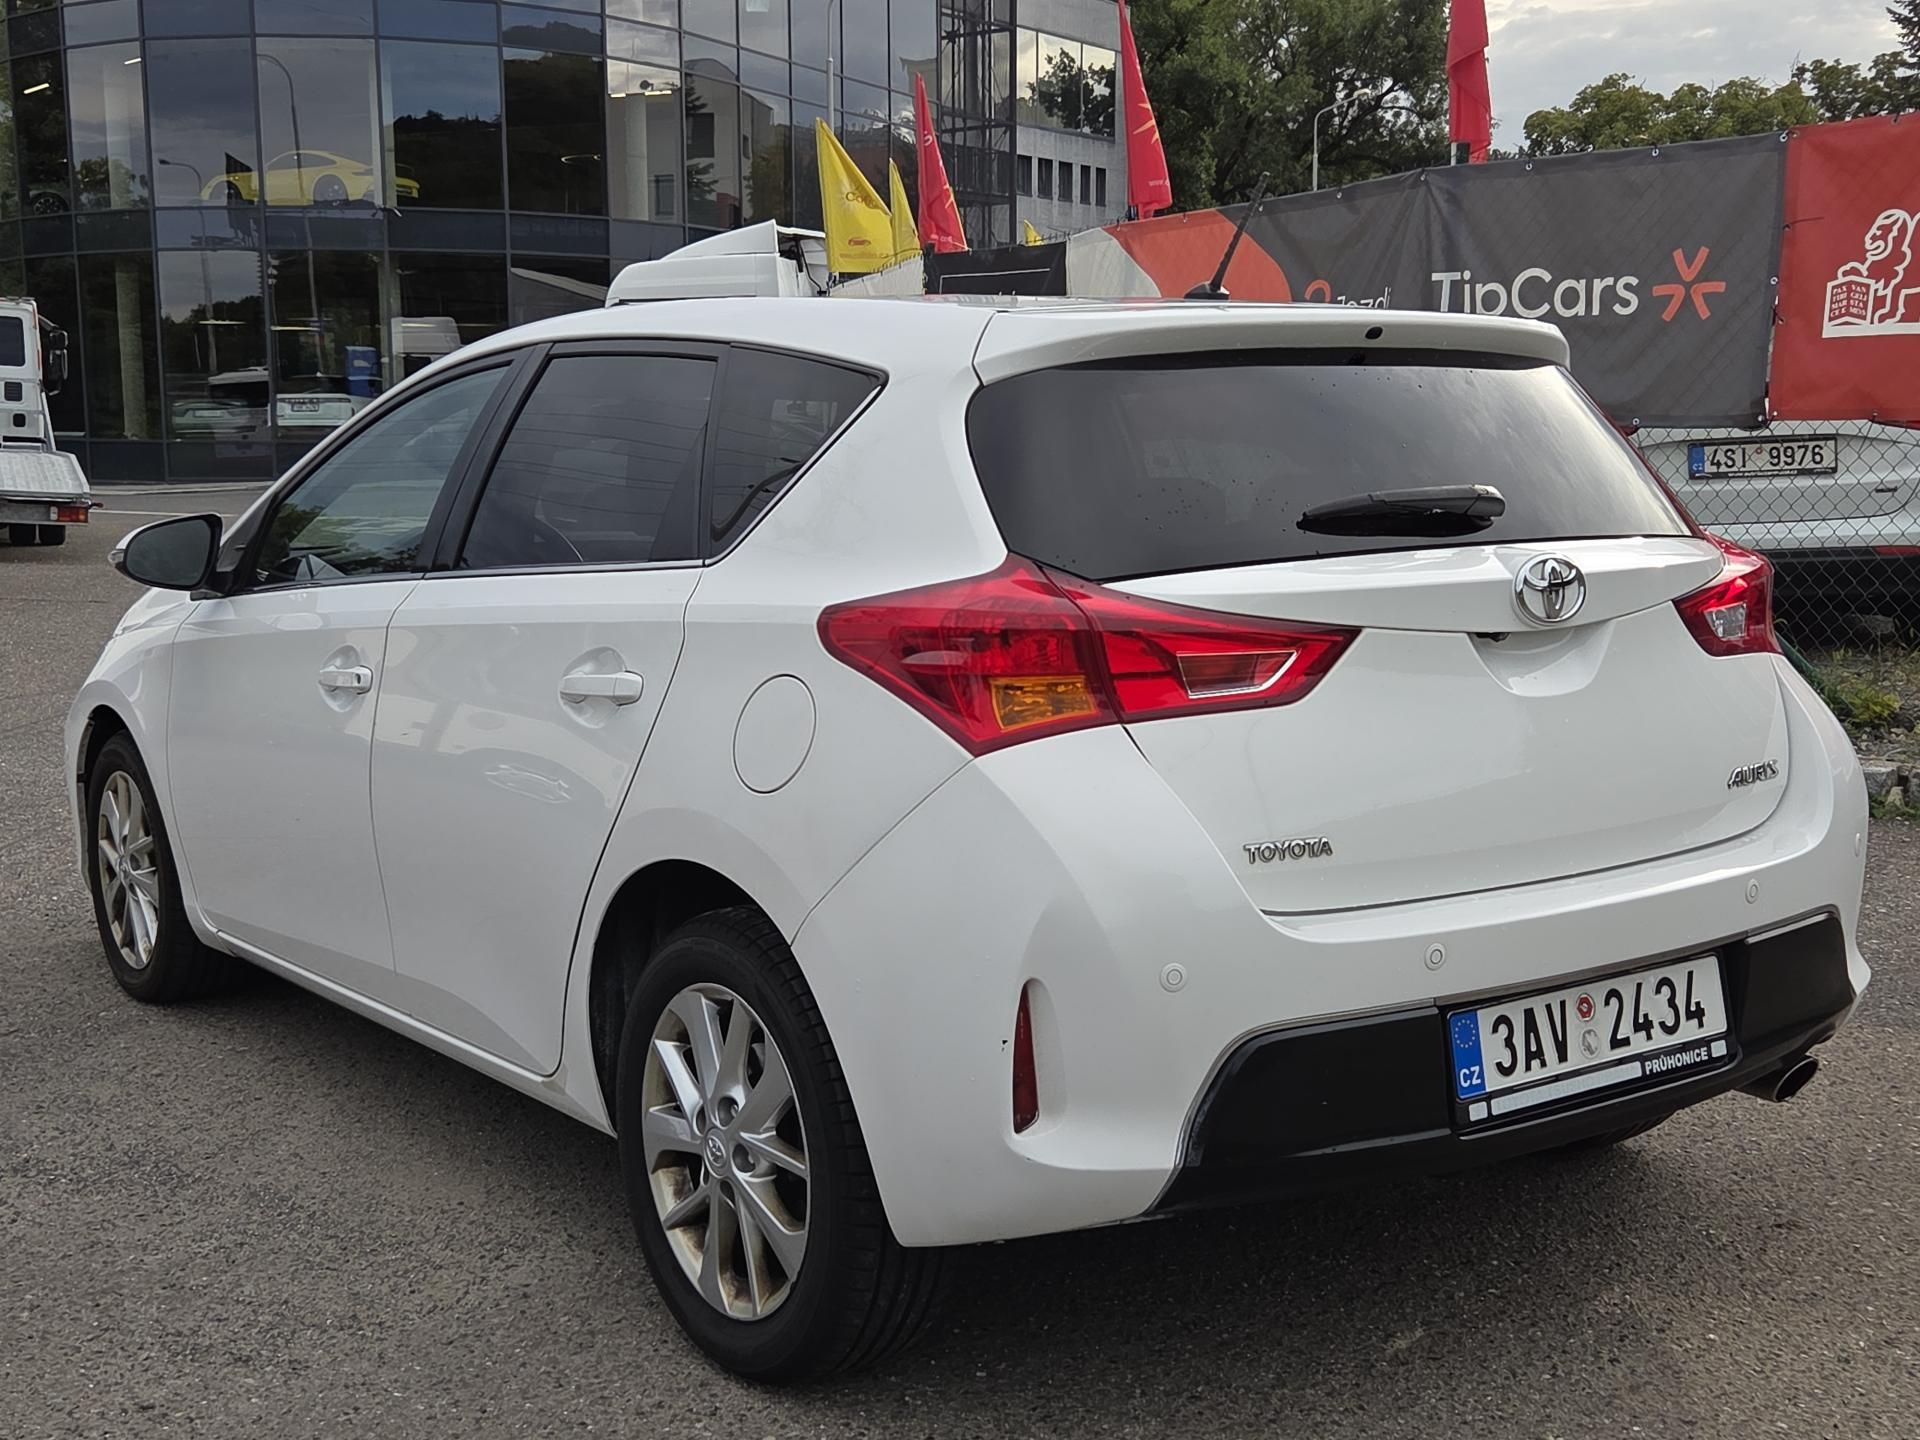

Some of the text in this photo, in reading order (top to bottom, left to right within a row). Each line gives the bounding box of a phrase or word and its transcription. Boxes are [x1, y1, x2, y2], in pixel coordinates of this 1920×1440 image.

[1431, 267, 1640, 318] TipCars
[1768, 444, 1824, 467] 9976
[1243, 836, 1333, 864] TOYOTA
[1491, 970, 1706, 1077] 3AV 2434
[1459, 1065, 1481, 1088] CZ
